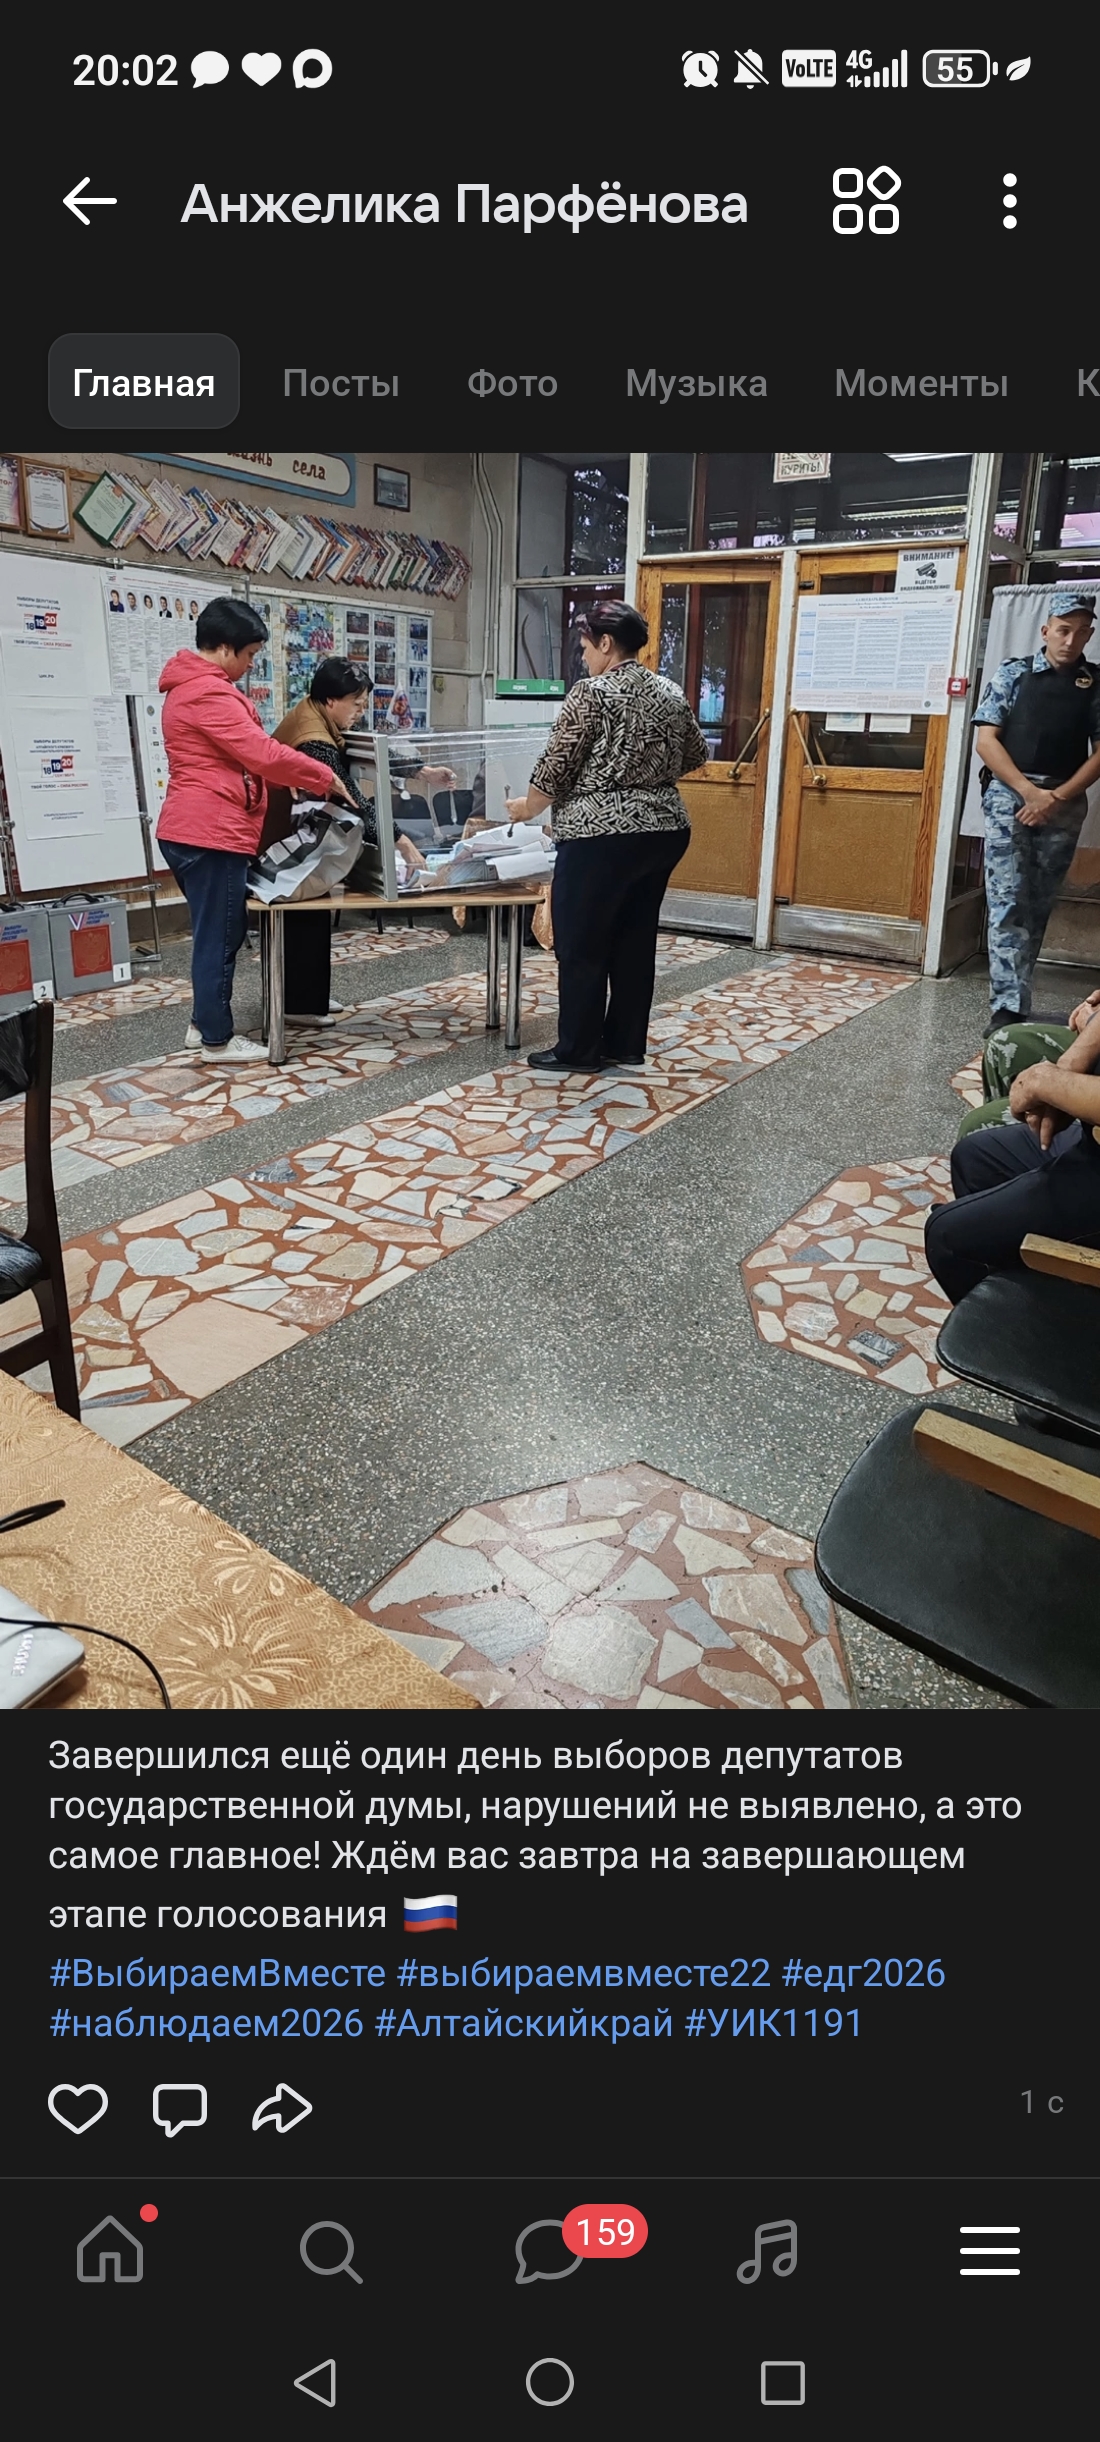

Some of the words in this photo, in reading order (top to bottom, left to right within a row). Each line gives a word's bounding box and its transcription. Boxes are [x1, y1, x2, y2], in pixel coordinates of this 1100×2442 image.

[292, 460, 326, 480] села
[781, 462, 820, 475] КУРИТЬ!
[903, 551, 955, 561] ВНИМАНИЕ!
[43, 767, 52, 775] 18
[119, 967, 124, 979] 1
[40, 985, 47, 998] 2
